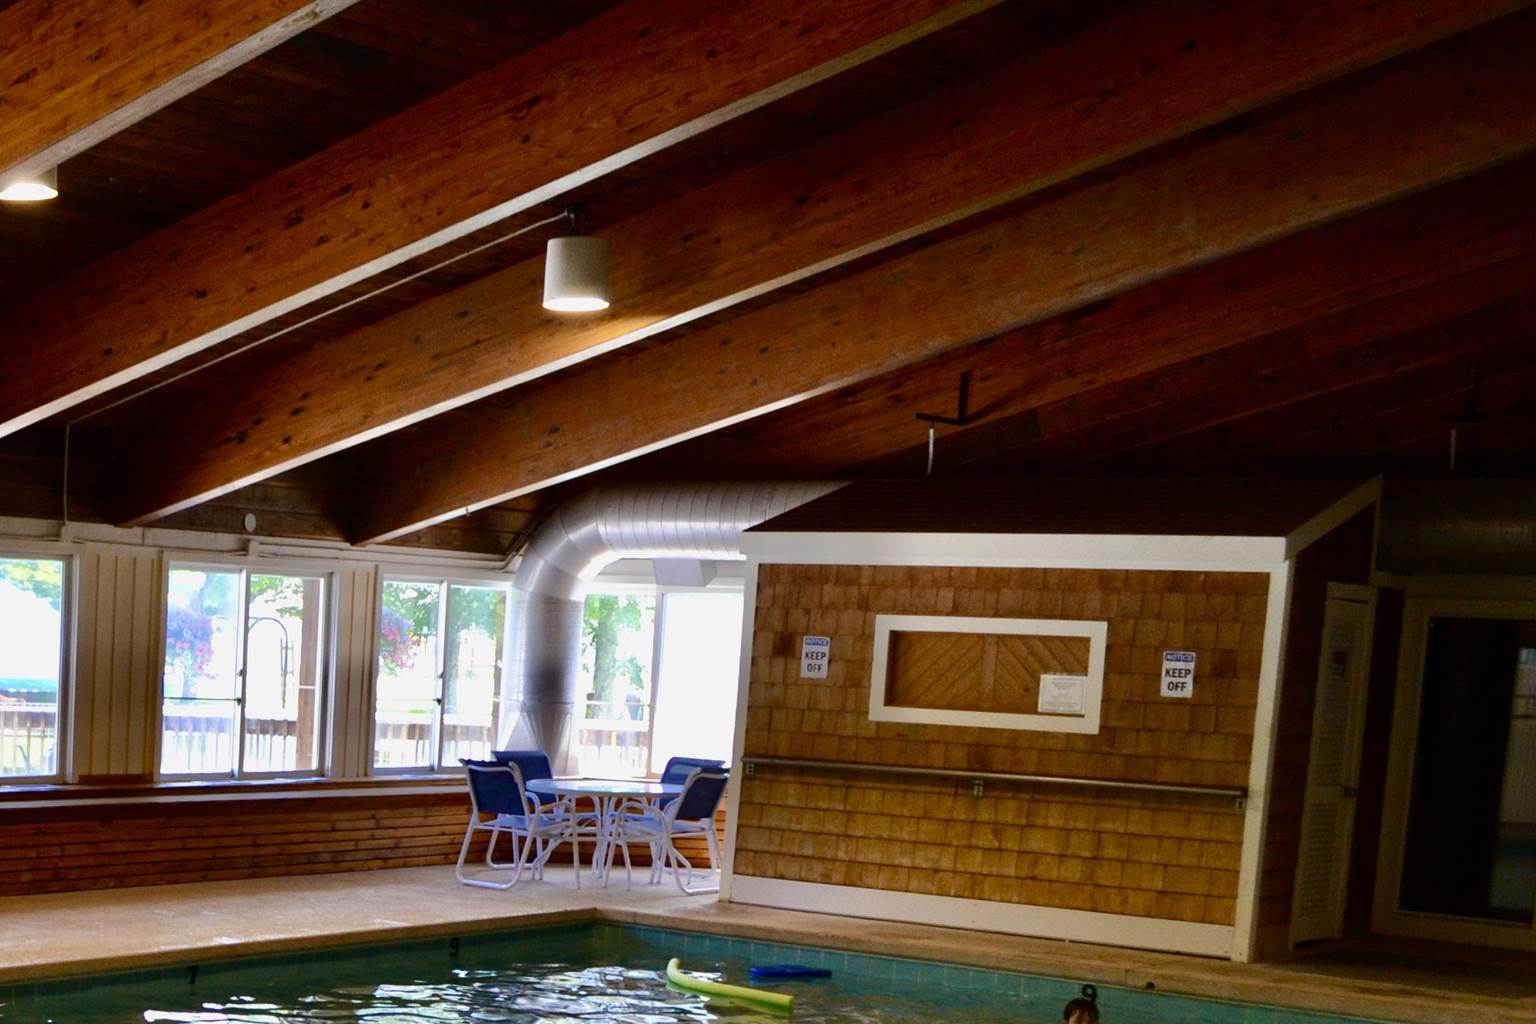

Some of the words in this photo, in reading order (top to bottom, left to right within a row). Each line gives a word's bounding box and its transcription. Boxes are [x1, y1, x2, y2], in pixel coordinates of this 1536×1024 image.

[805, 651, 826, 660] KEEP
[807, 663, 823, 672] OFF
[1165, 668, 1191, 678] KEEP
[1167, 681, 1187, 691] OFF
